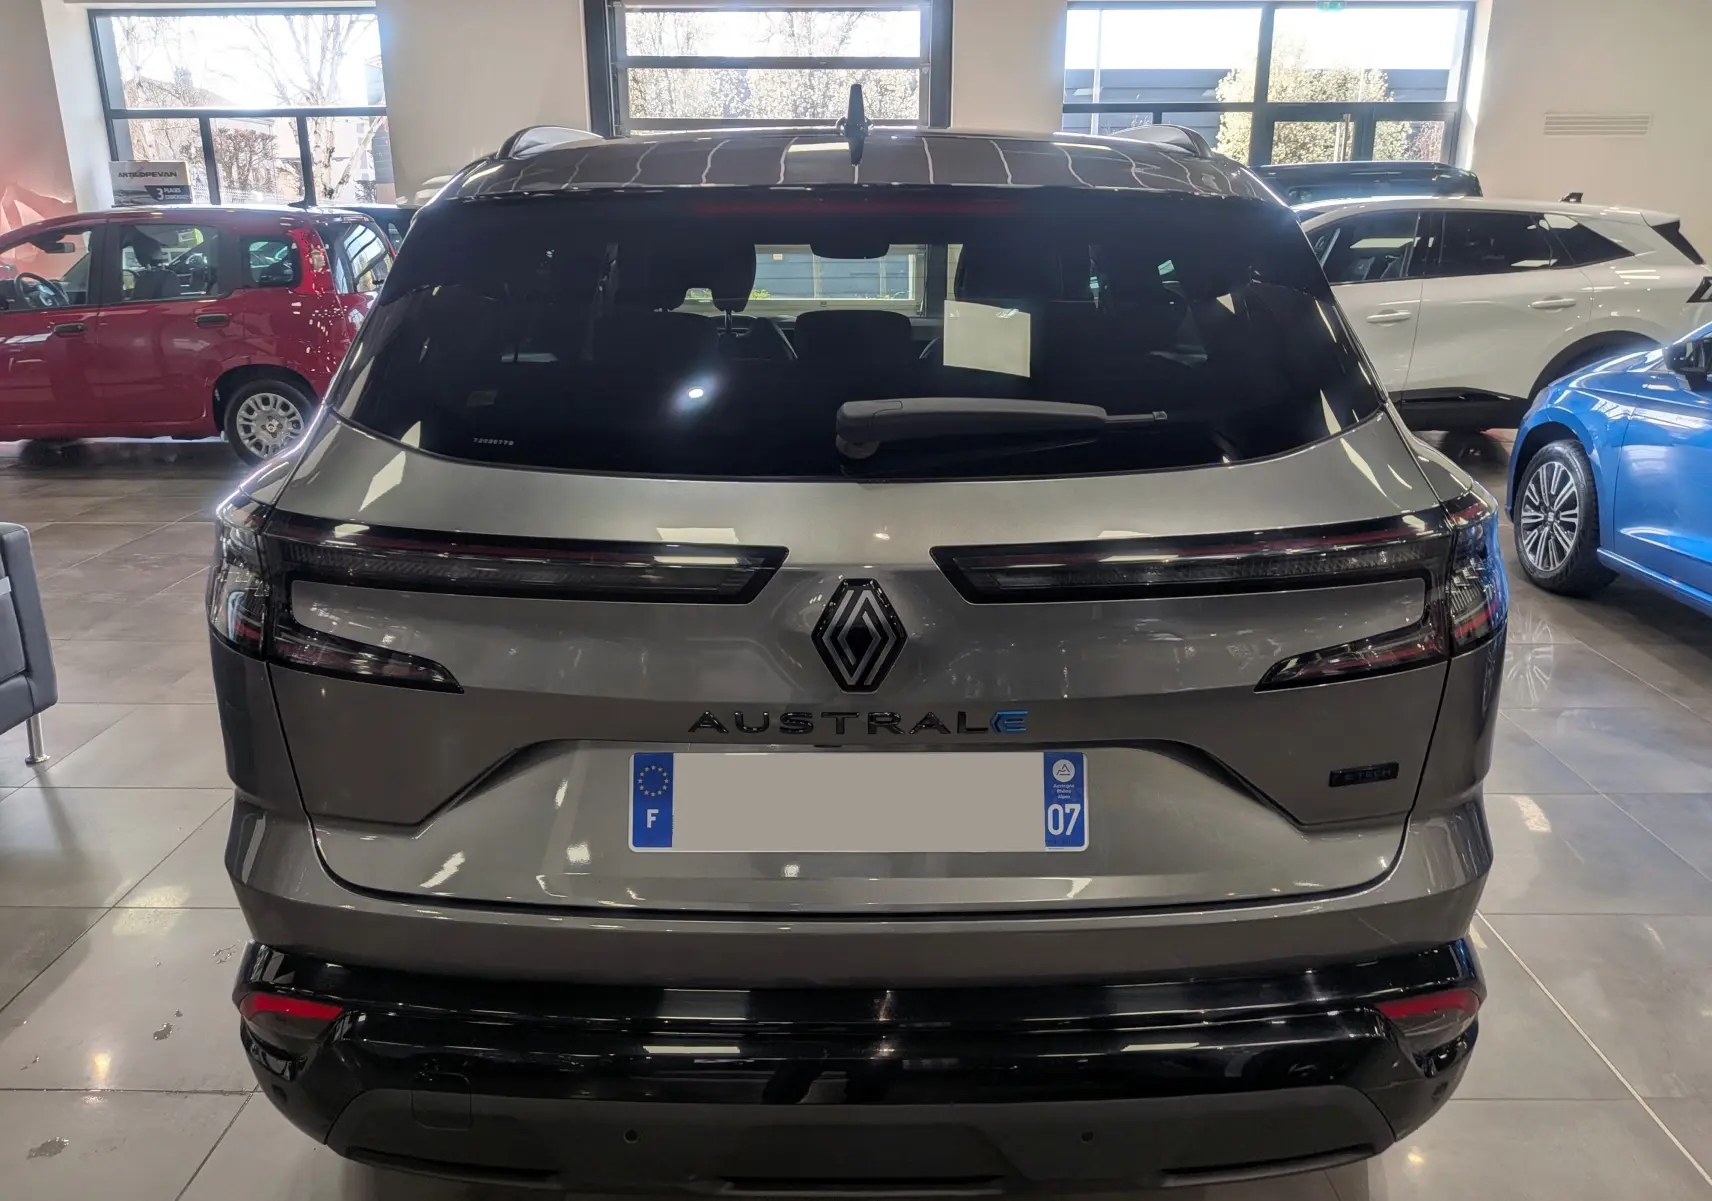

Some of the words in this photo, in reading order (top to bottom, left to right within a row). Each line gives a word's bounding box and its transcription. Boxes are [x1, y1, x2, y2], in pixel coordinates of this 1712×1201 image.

[156, 188, 164, 200] 3
[646, 809, 659, 829] F
[1047, 803, 1081, 836] 07
